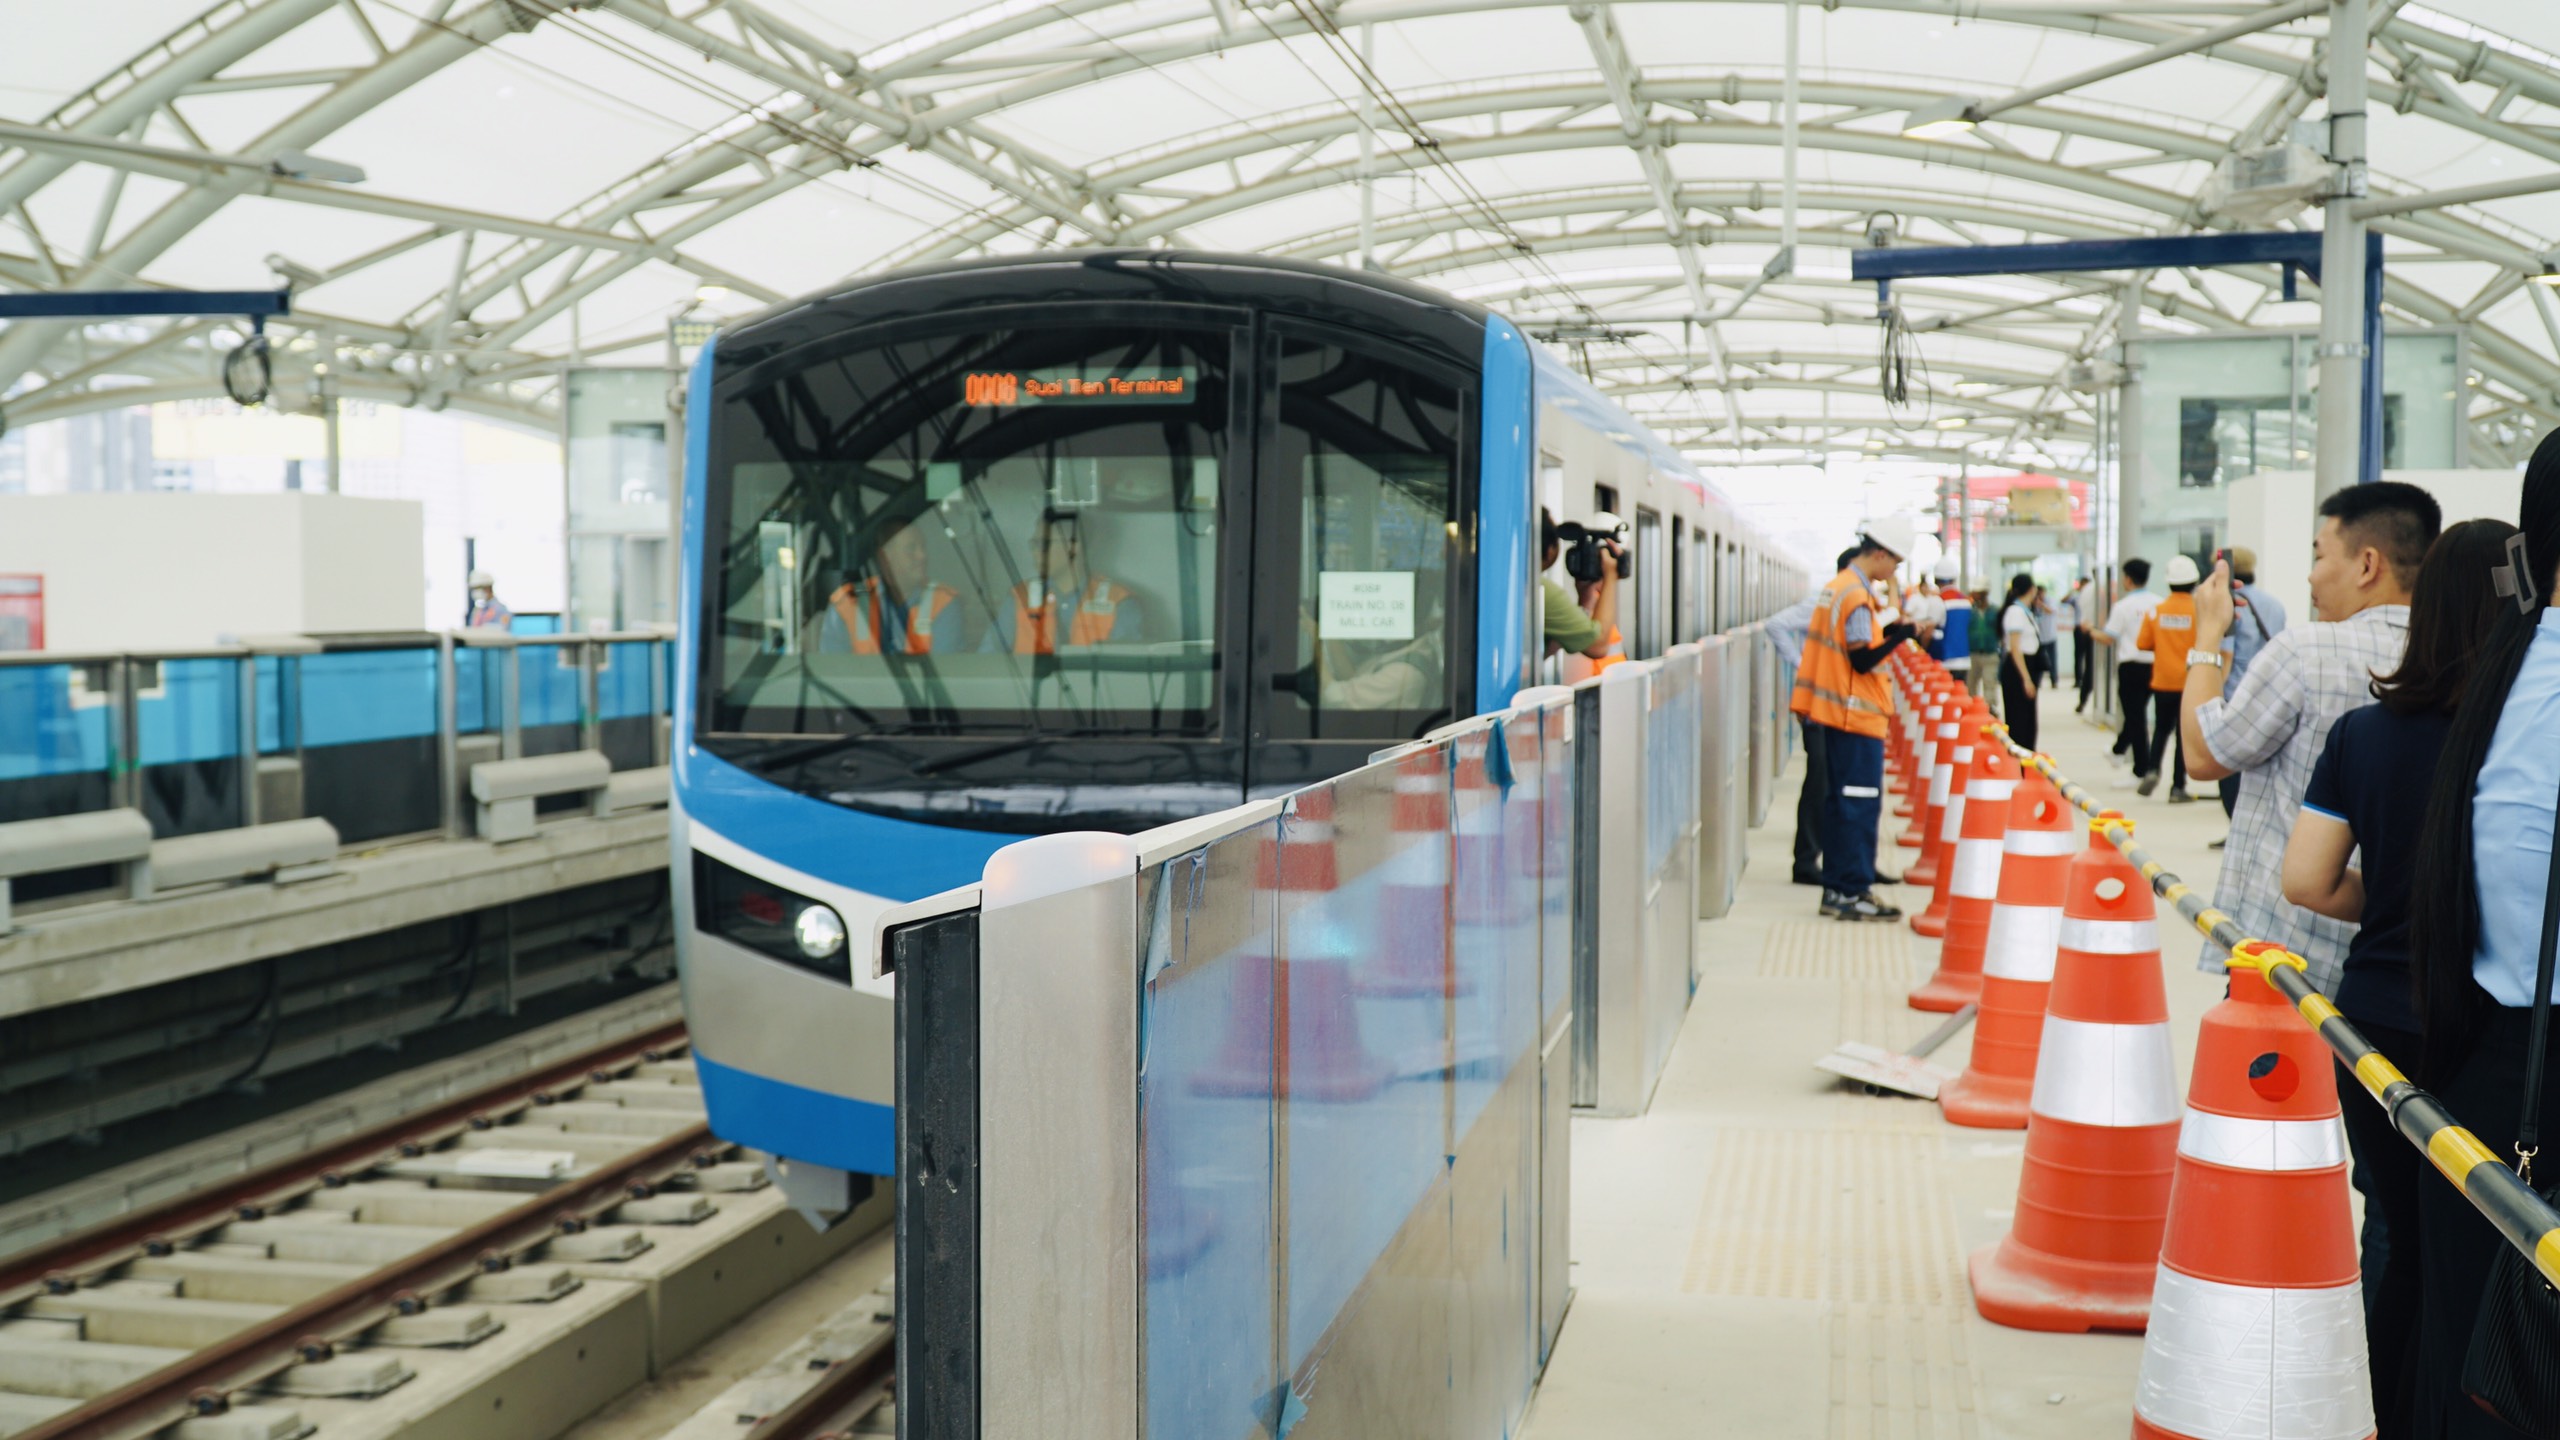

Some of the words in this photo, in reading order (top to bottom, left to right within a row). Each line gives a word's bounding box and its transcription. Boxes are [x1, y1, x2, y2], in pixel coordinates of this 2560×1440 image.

[1107, 376, 1184, 395] Terminal
[1330, 600, 1363, 609] TRAIN
[1371, 616, 1395, 627] CAR
